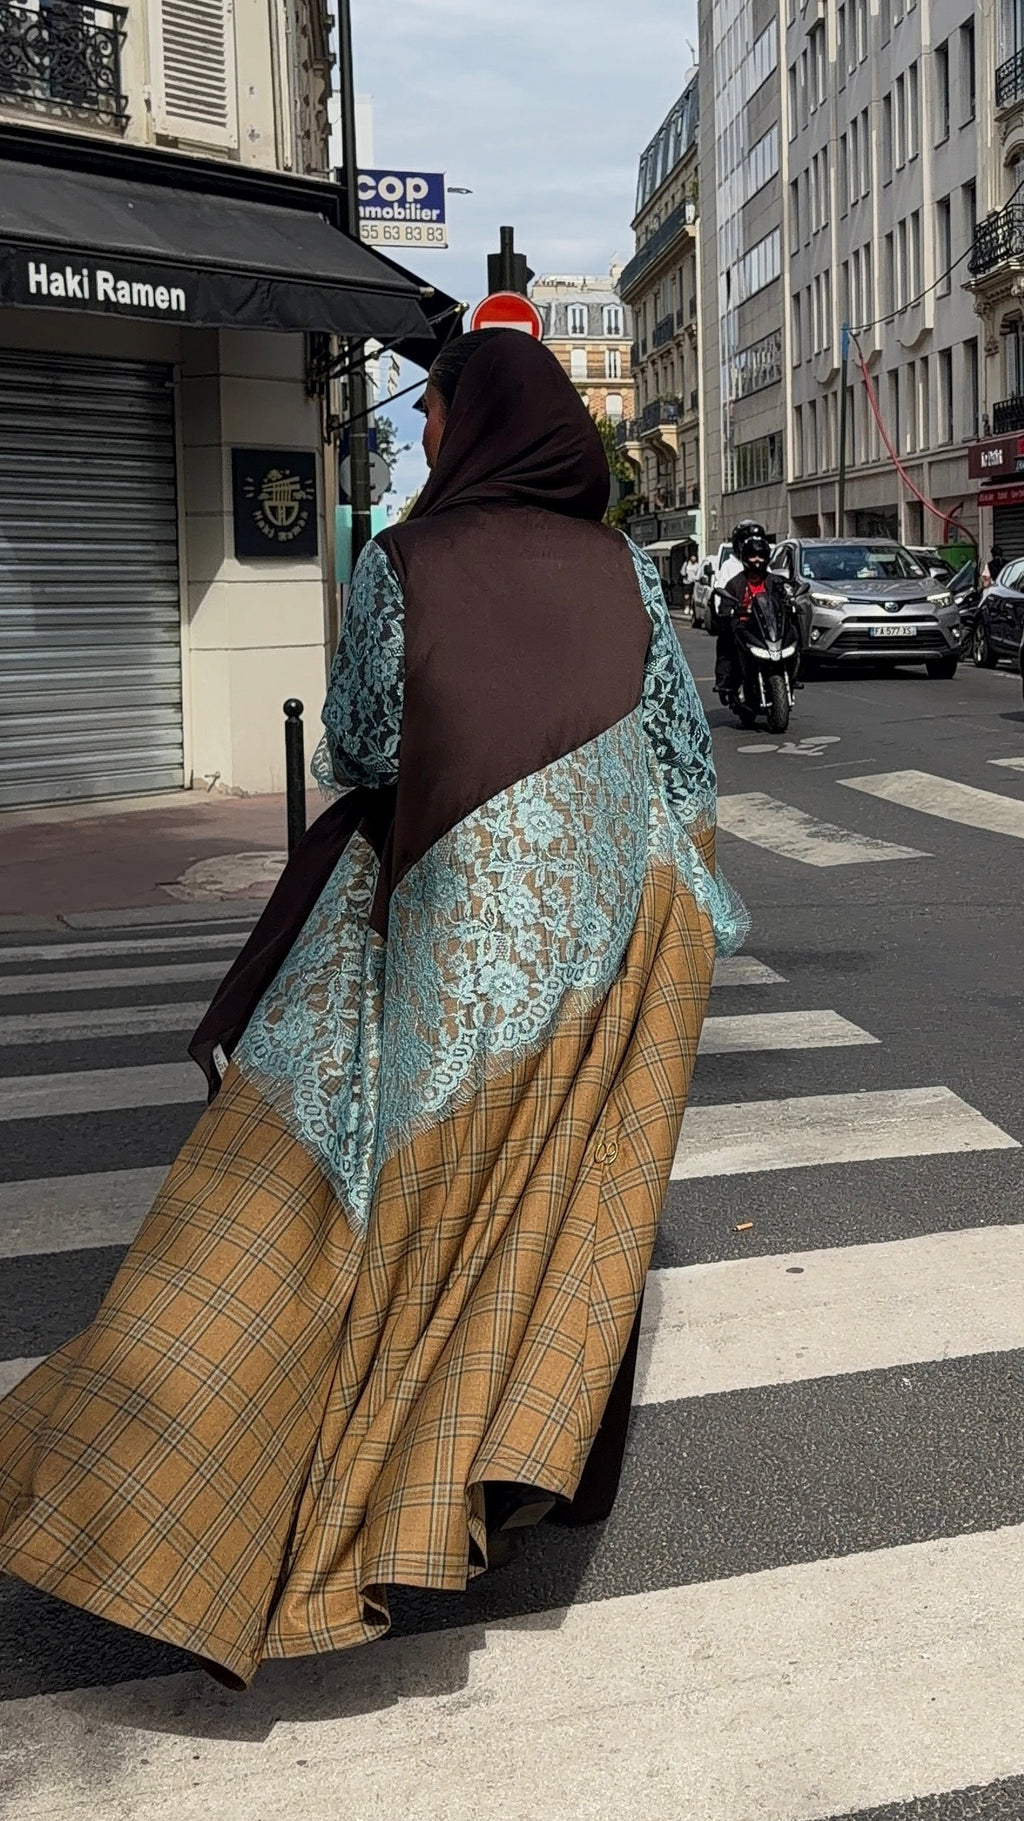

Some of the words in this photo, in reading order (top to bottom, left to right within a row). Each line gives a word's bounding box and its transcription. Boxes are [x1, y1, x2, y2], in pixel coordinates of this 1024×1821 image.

[361, 224, 378, 239] 55
[383, 225, 400, 240] 63
[405, 226, 422, 241] 83
[427, 227, 444, 242] 83
[28, 261, 90, 300] Haki
[96, 269, 187, 312] Ramen
[875, 627, 885, 635] FA
[887, 627, 900, 635] 577
[902, 627, 912, 635] XS
